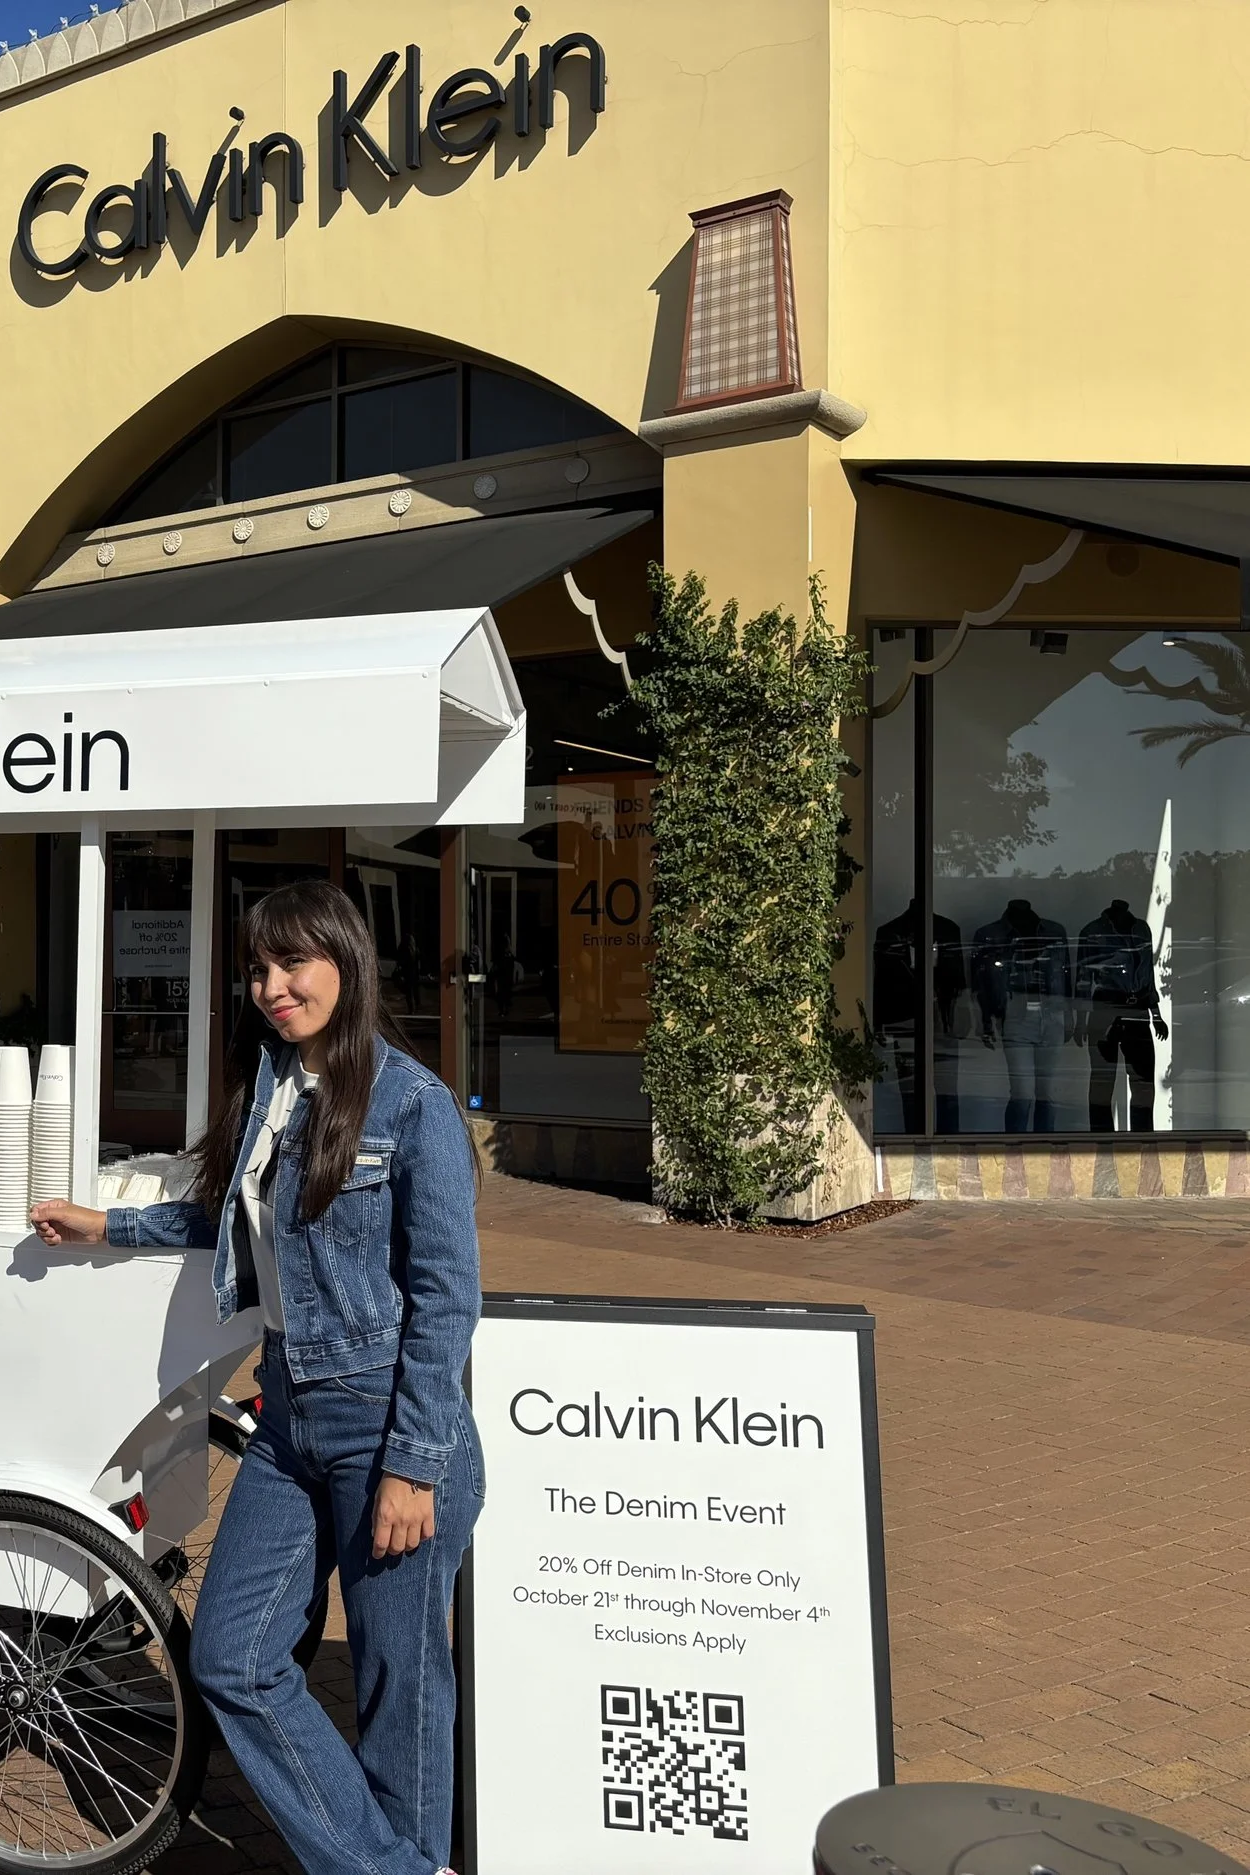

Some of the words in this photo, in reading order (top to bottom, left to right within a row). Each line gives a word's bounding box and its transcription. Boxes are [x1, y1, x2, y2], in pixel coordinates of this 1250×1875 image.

[17, 105, 304, 275] Calvin
[332, 5, 606, 192] Klein
[570, 878, 641, 926] 40
[583, 933, 622, 946] Entire
[510, 1388, 679, 1442] Calvin
[695, 1396, 824, 1449] Klein
[544, 1487, 596, 1514] The
[605, 1490, 697, 1520] Denim
[707, 1496, 786, 1525] Event
[538, 1555, 578, 1574] 20%
[583, 1558, 612, 1576] Off
[617, 1560, 676, 1580] Denim
[681, 1564, 751, 1585] In-Store
[756, 1569, 801, 1592] Only
[513, 1586, 588, 1607] October
[593, 1591, 619, 1608] 21st
[624, 1594, 696, 1617] through
[701, 1599, 801, 1622] November
[806, 1605, 831, 1623] 4th
[594, 1623, 687, 1647] Exclusions
[692, 1631, 747, 1655] Apply
